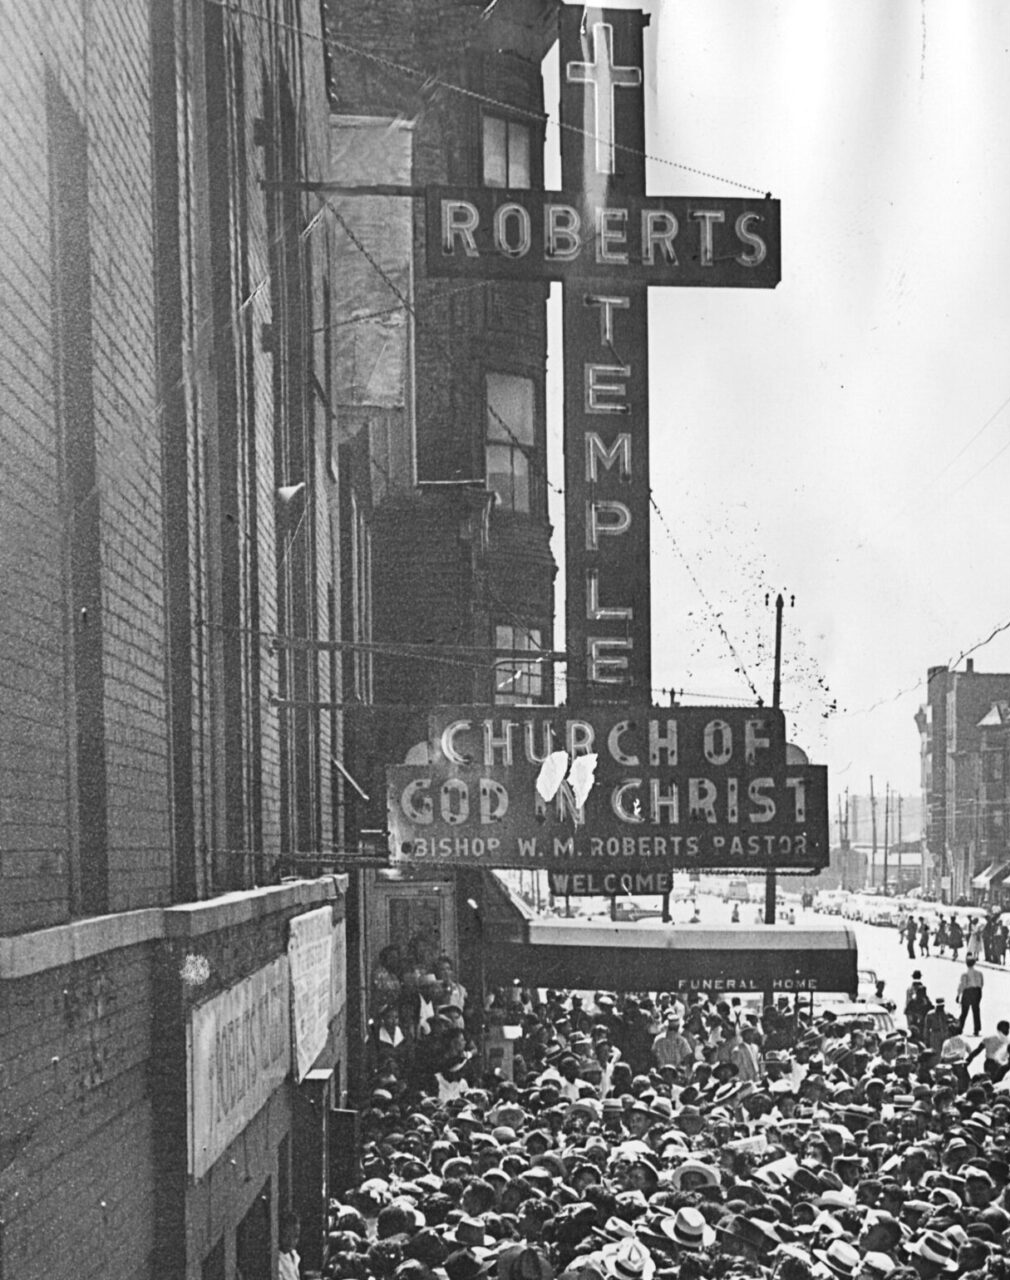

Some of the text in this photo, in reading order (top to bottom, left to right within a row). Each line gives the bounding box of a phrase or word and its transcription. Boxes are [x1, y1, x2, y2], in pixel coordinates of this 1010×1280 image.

[441, 199, 767, 267] ROBERTS
[583, 295, 633, 686] TEMPLE
[441, 719, 771, 766] CHURCH OF
[402, 778, 508, 825] GOD
[611, 777, 806, 824] CHRIST
[414, 836, 808, 857] BISHOP W. M. ROBERTS PASTOR
[553, 873, 669, 893] WELCOME
[678, 979, 817, 989] FUNERAL HOME
